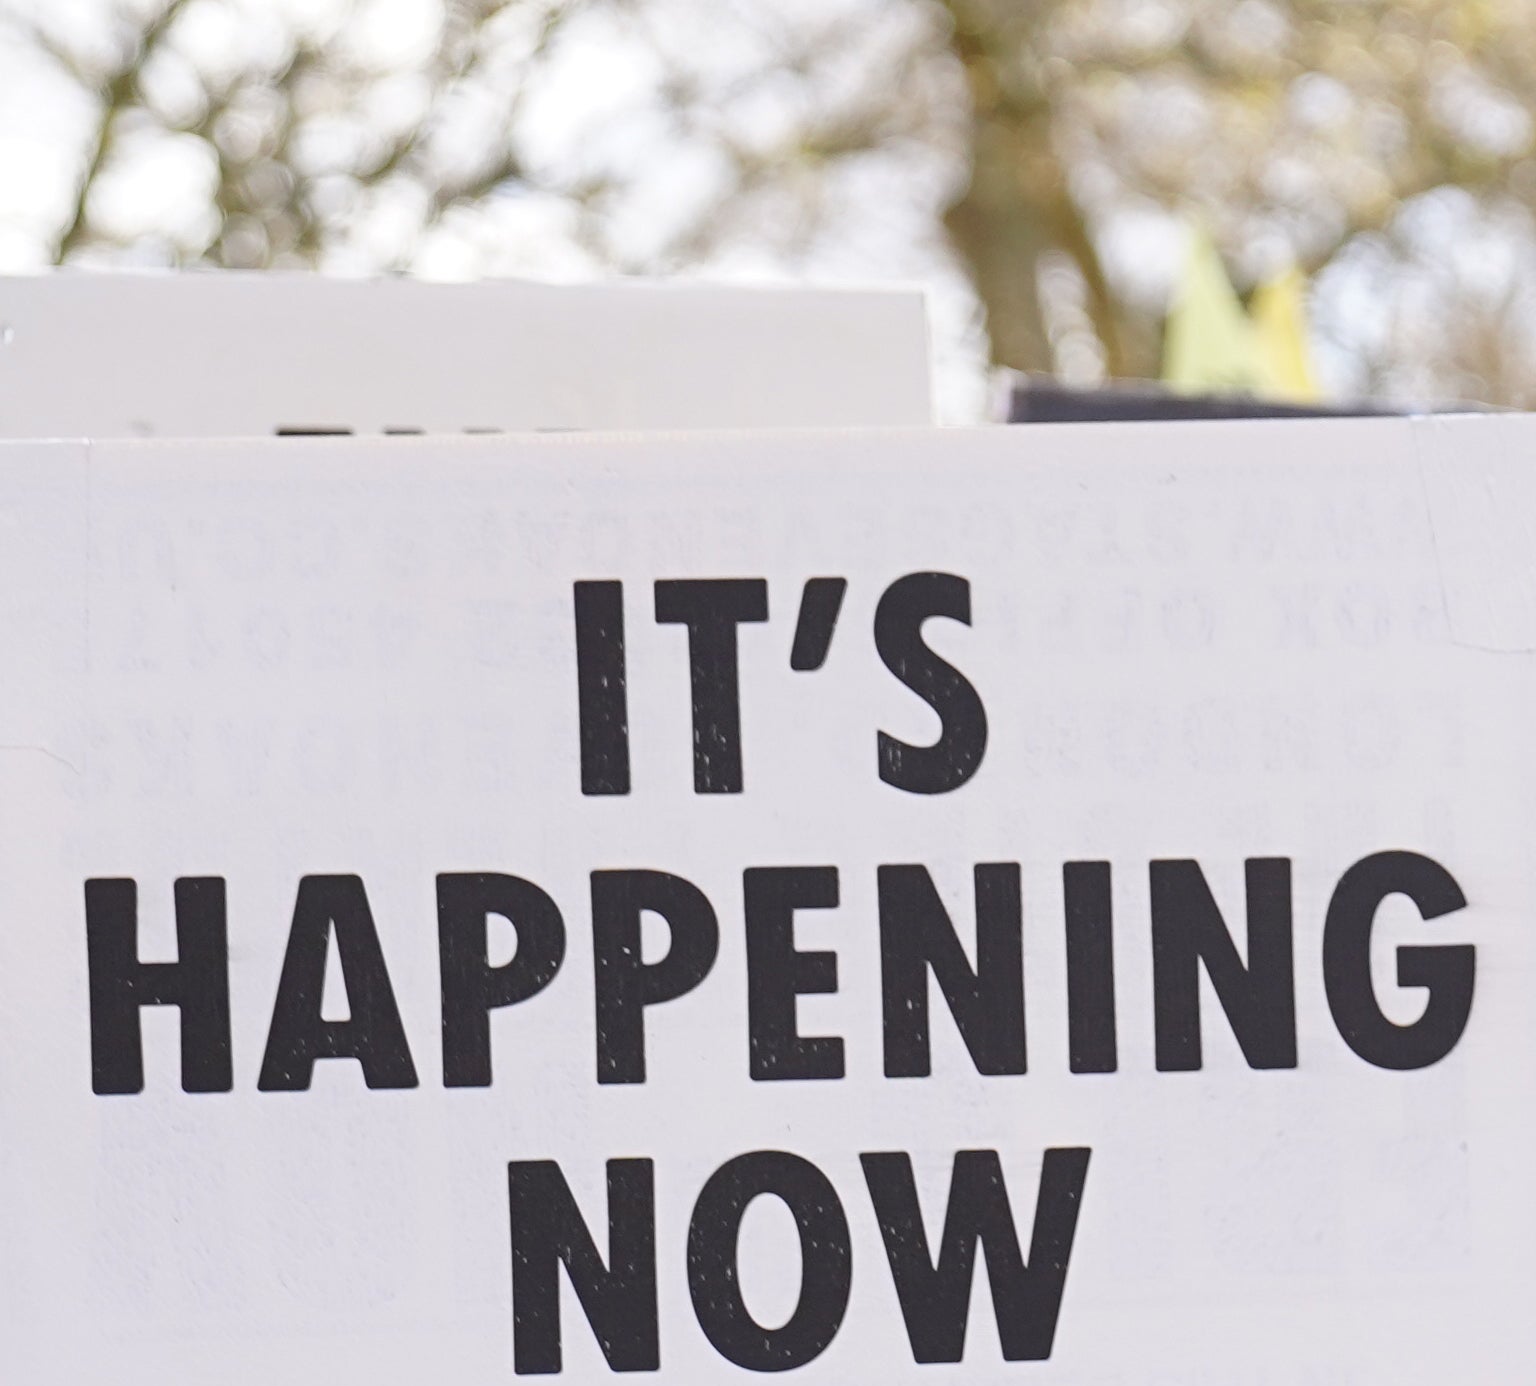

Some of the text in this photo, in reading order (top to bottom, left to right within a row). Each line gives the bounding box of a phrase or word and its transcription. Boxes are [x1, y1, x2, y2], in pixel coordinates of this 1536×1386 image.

[574, 571, 988, 797] IT'S
[85, 850, 1476, 1096] HAPPENING
[508, 1146, 1092, 1376] NOW
